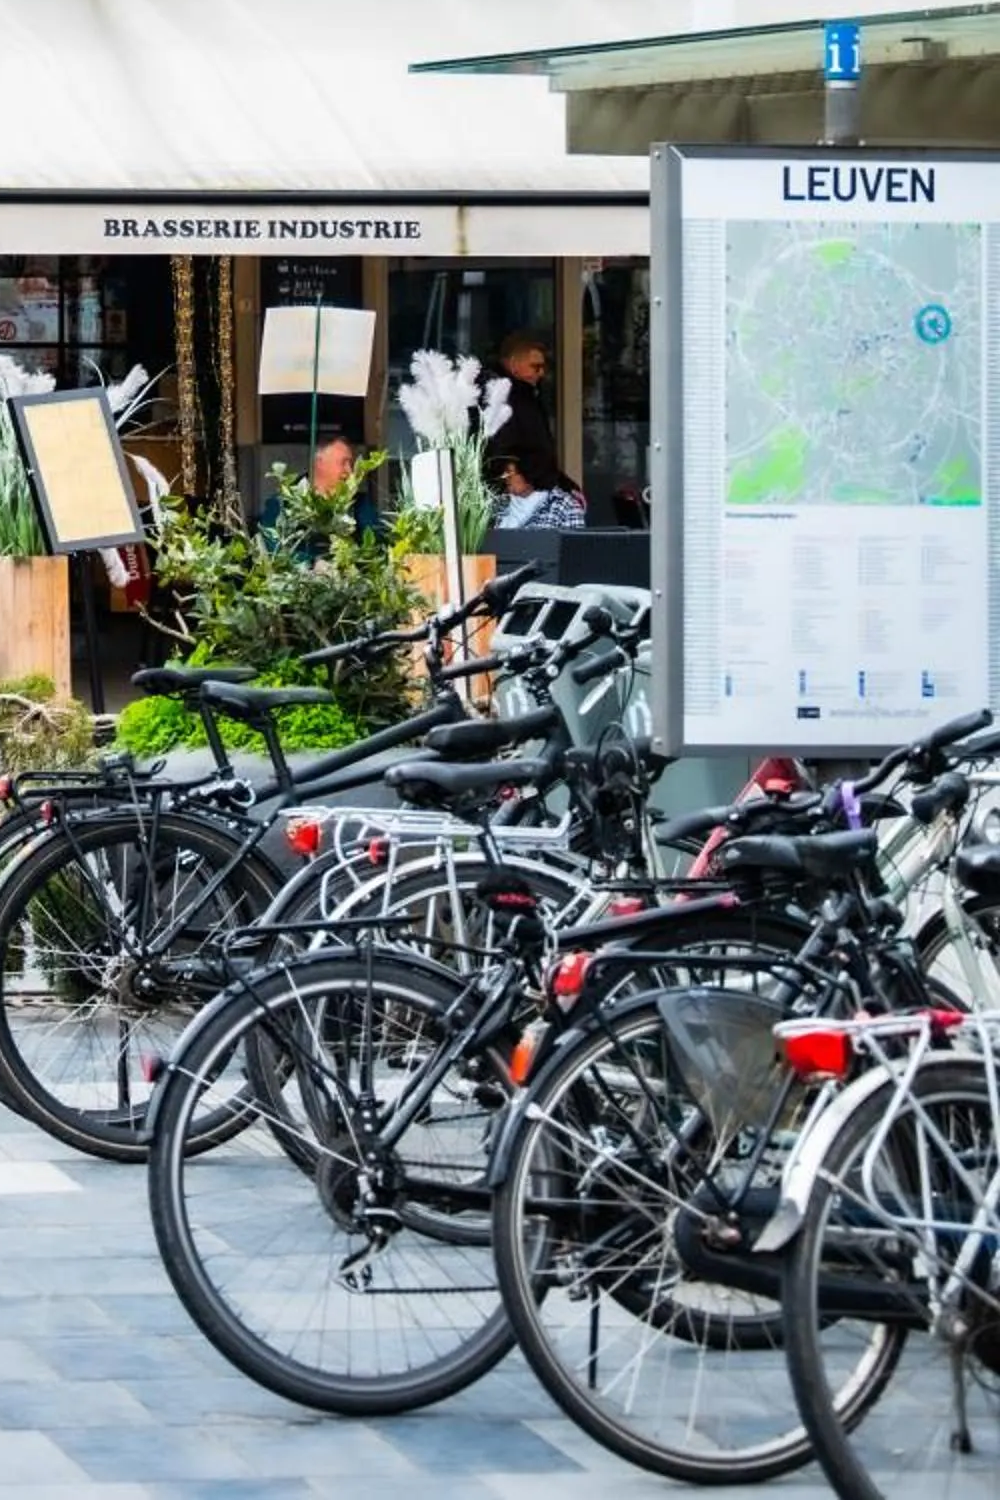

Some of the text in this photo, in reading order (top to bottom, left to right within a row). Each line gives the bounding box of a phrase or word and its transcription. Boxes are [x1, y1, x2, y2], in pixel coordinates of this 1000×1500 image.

[783, 166, 935, 203] LEUVEN
[103, 218, 422, 240] BRASSERIE INDUSTRIE
